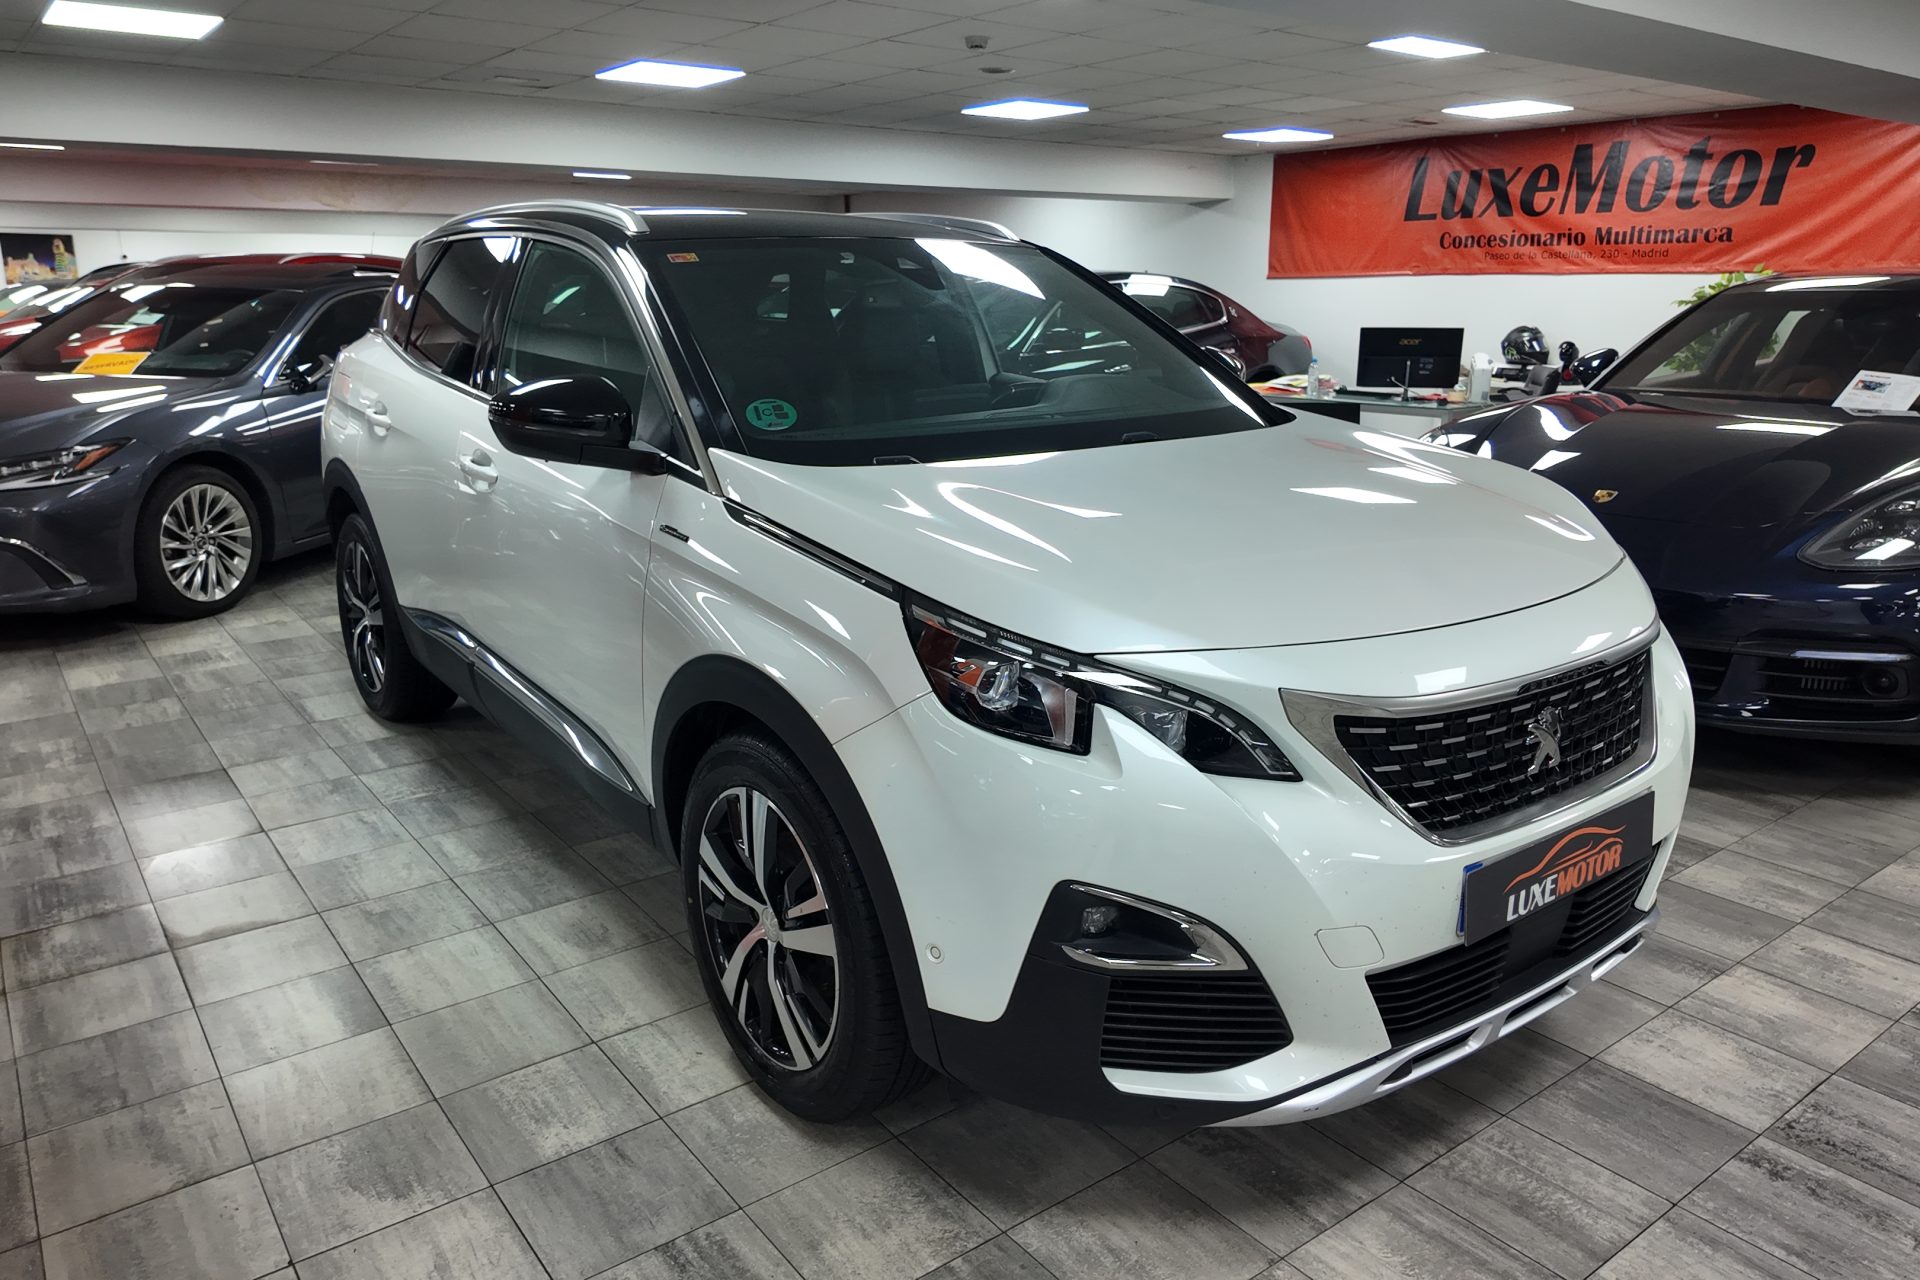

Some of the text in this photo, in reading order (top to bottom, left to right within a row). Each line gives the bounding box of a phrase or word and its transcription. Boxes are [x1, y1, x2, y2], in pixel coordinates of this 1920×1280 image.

[1403, 135, 1817, 222] LuxeMotor
[1440, 225, 1733, 249] Concesionario Multimarca
[1484, 251, 1510, 260] Paseo
[1513, 251, 1525, 260] de
[1528, 251, 1537, 260] la
[1600, 249, 1619, 258] 230
[1632, 248, 1669, 258] Madrid
[1506, 844, 1623, 921] LUXEMOTOR
